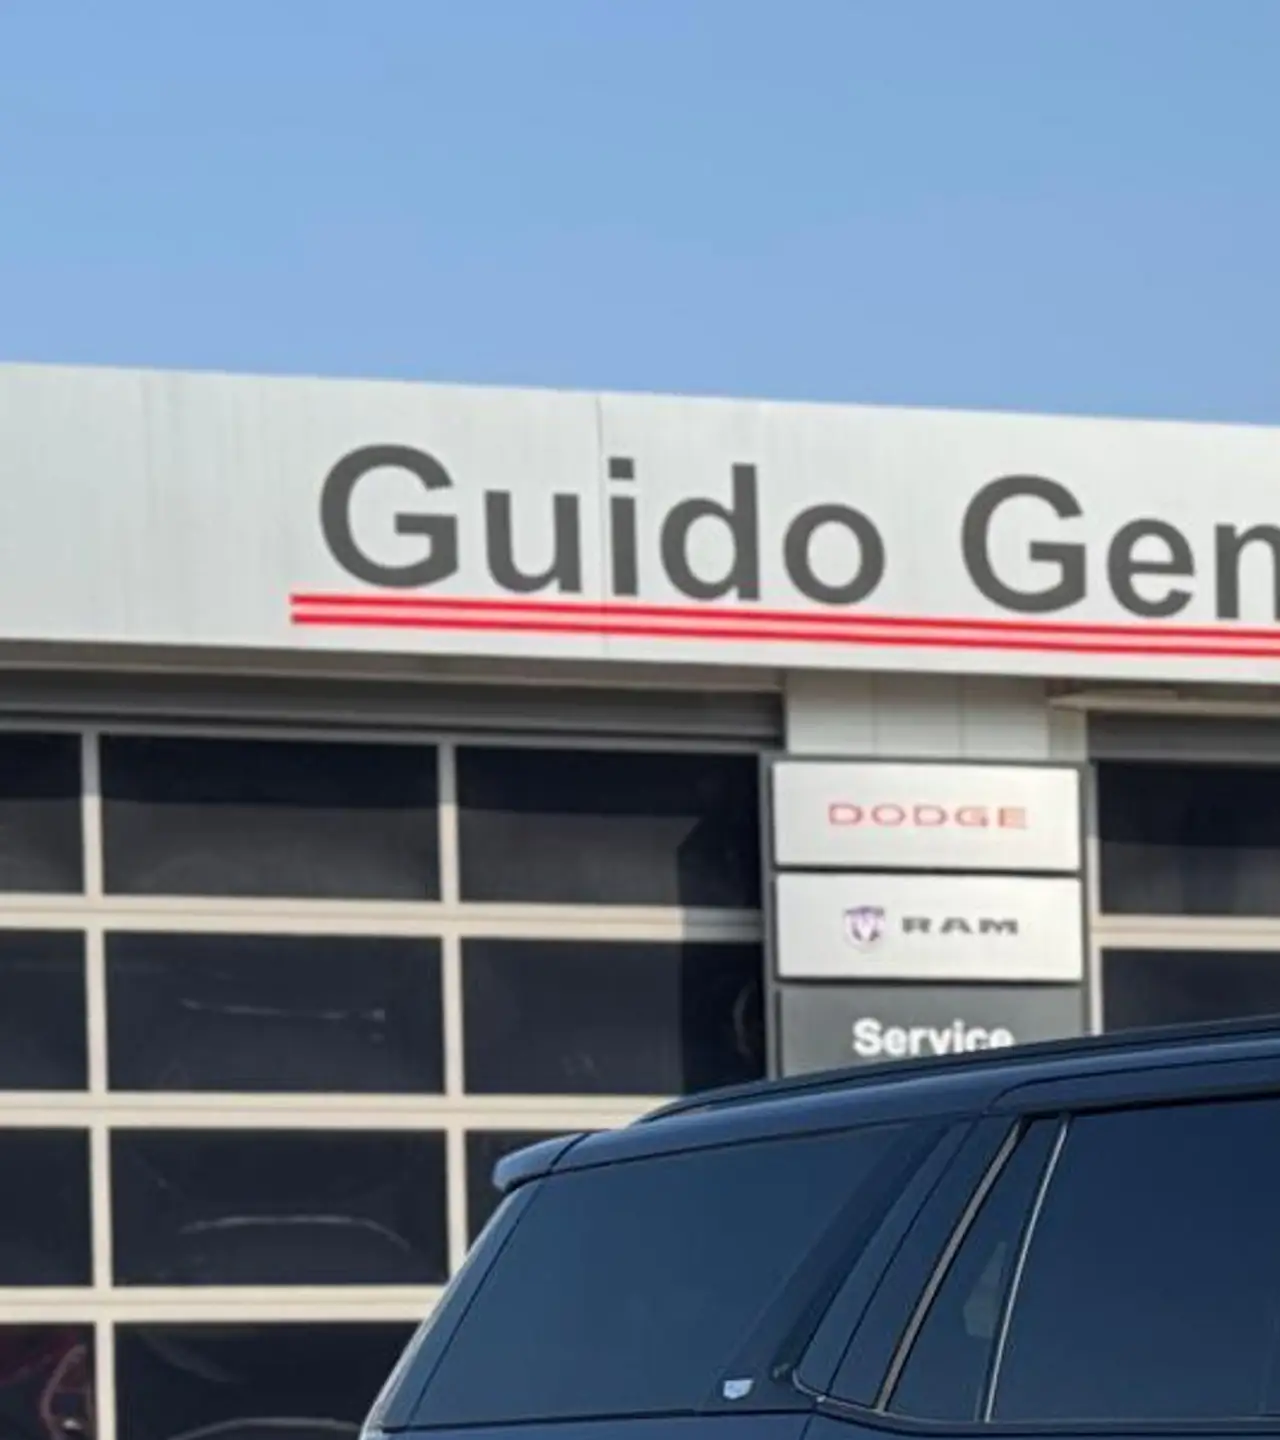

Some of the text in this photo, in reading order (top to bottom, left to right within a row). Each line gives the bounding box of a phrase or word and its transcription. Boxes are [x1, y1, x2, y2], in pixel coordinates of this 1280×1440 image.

[319, 444, 886, 607] Guido
[828, 803, 1027, 828] DODGE
[902, 916, 1018, 935] RAM
[852, 1018, 1016, 1057] Service
